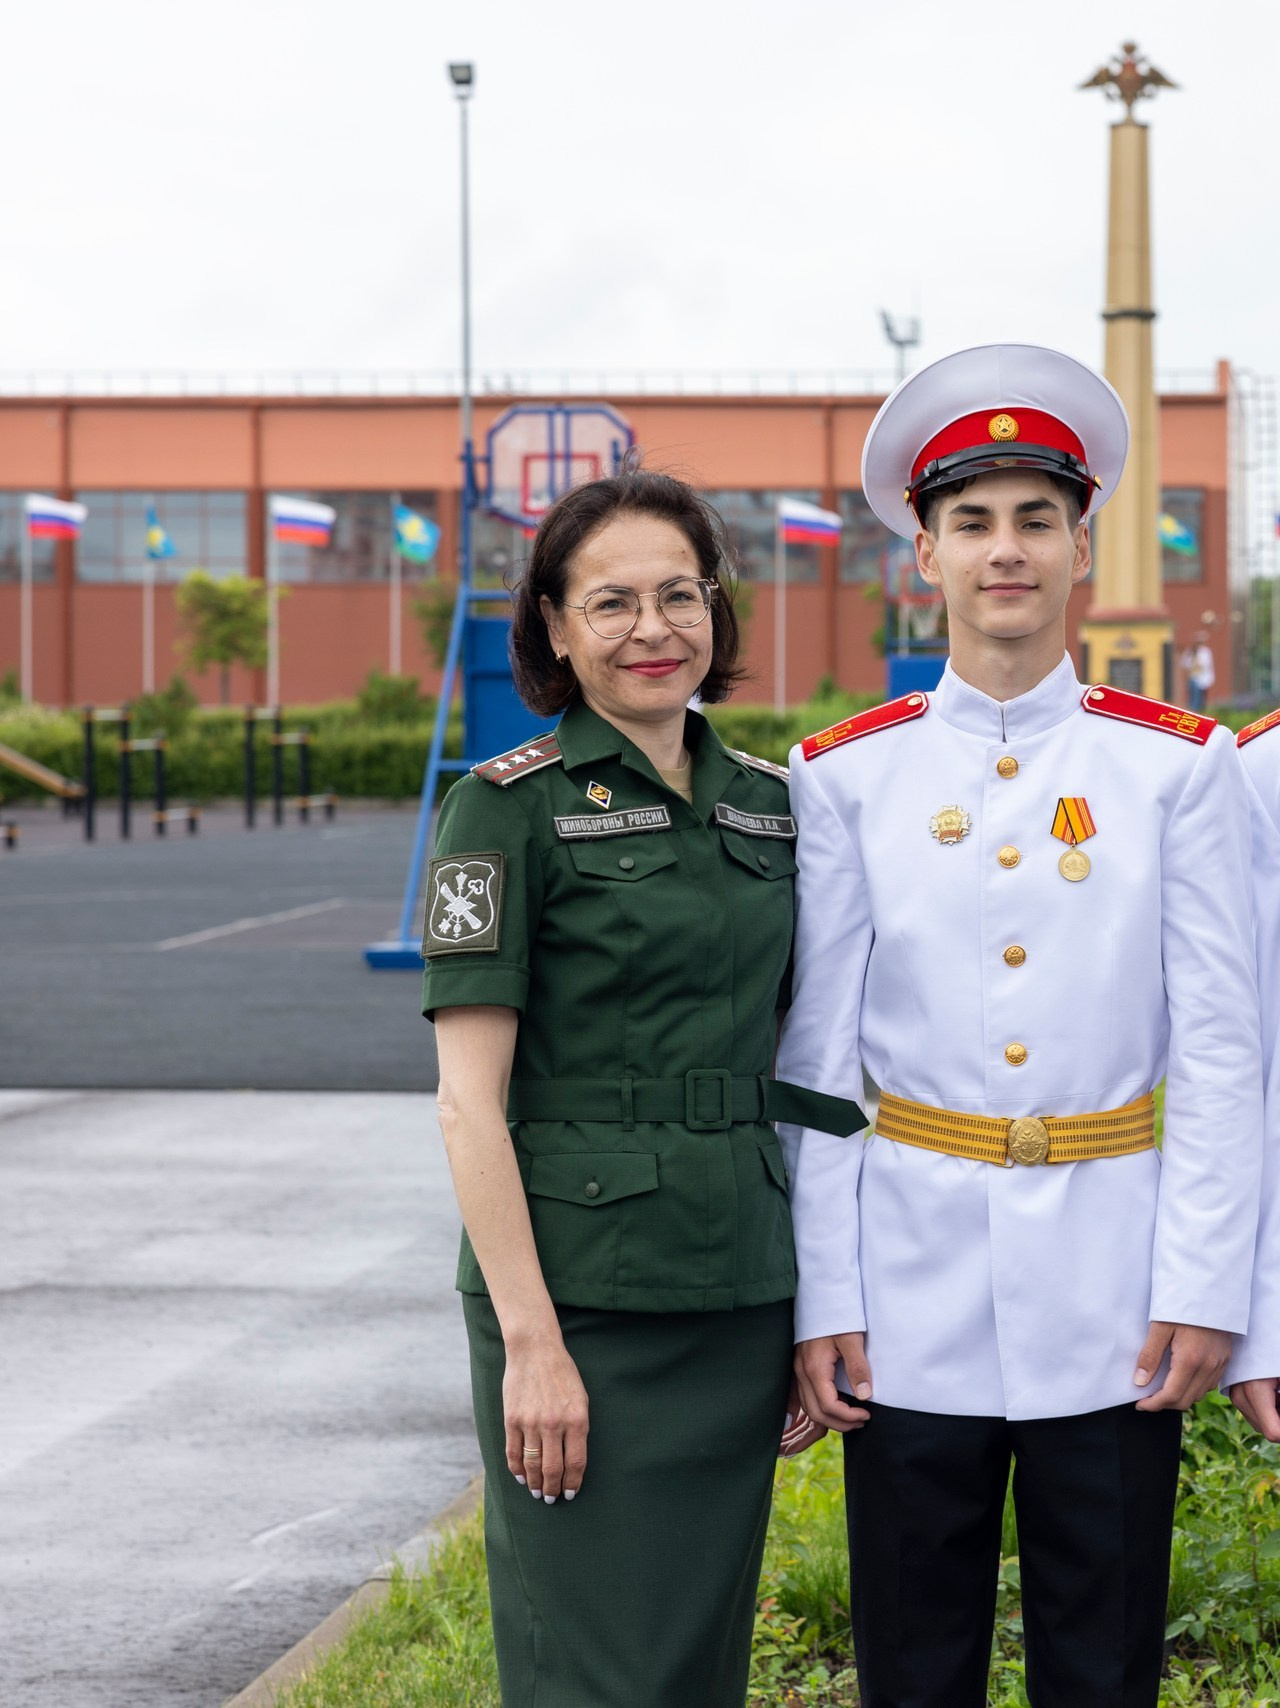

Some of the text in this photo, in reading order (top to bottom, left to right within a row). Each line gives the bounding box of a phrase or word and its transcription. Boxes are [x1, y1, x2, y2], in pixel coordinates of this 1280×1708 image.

[1177, 713, 1200, 734] СВУ
[560, 810, 665, 833] МИНОБОРОНЫ РОССИИ
